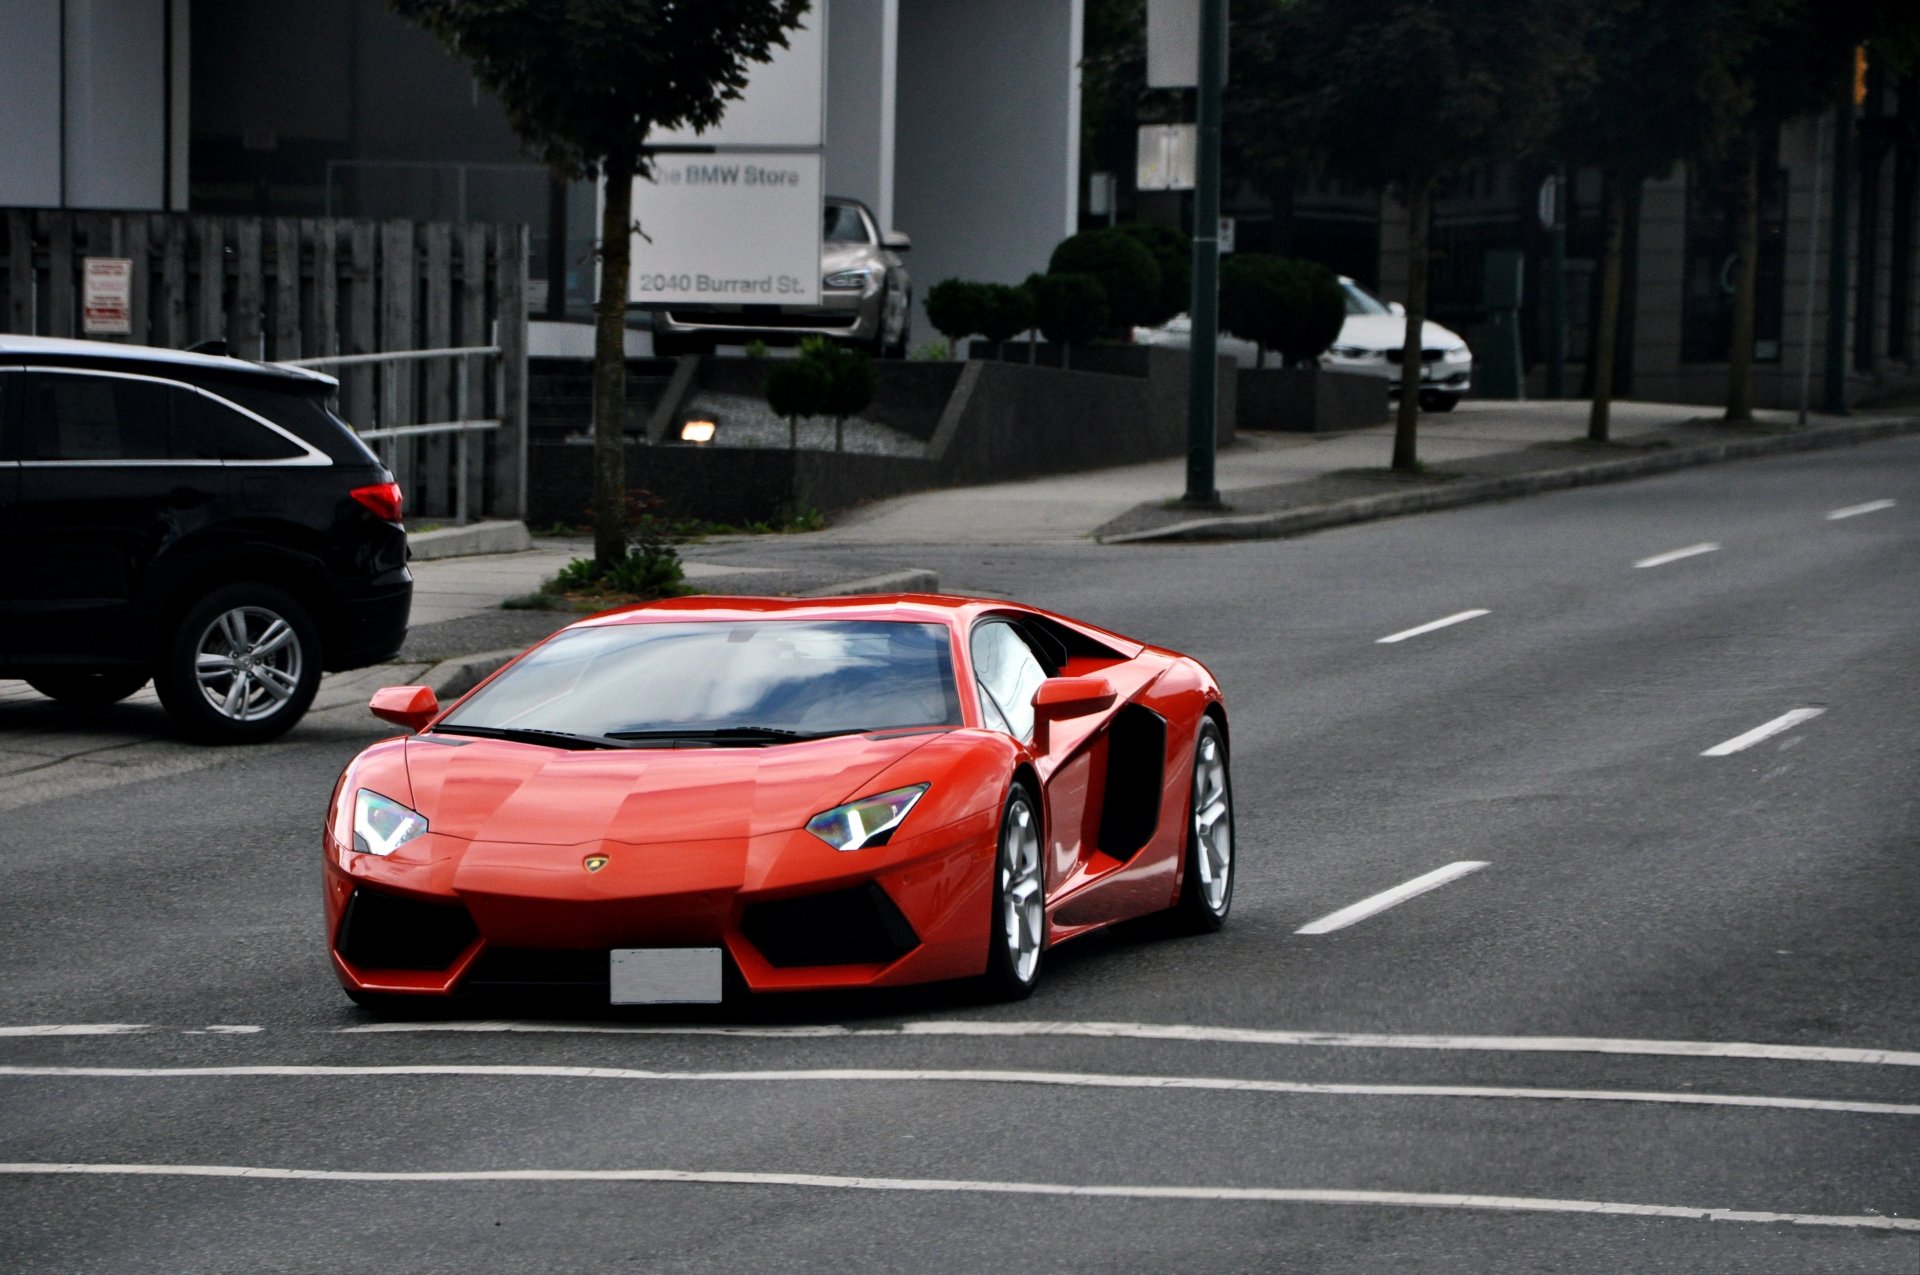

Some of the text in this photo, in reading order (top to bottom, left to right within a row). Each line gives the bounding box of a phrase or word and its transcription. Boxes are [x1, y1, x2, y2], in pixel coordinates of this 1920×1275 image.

[648, 164, 799, 187] he BMW Store
[640, 273, 805, 294] 2040 Burrard St.
